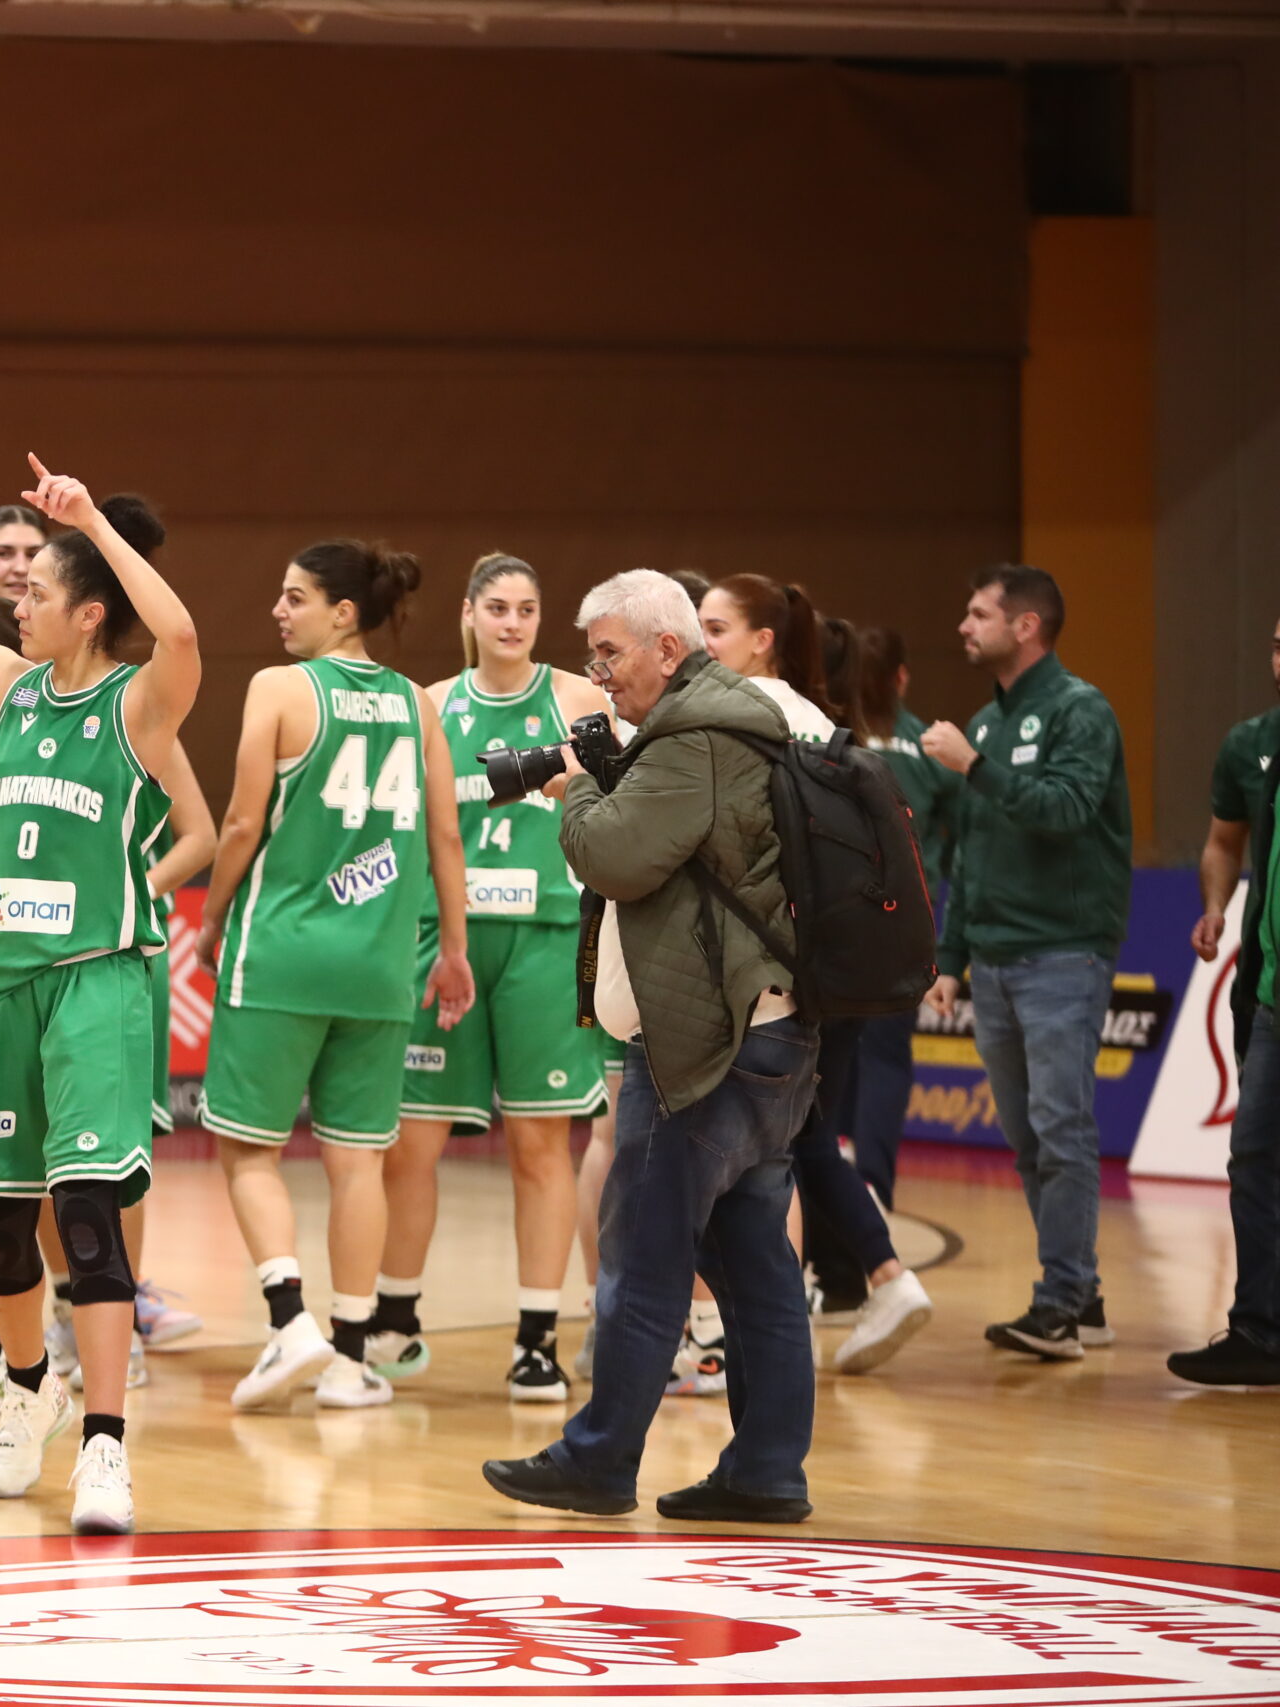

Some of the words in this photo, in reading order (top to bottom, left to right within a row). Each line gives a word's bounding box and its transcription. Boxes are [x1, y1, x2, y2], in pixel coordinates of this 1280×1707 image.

[320, 734, 421, 831] 44
[17, 821, 40, 860] 0
[478, 817, 512, 853] 14
[328, 855, 395, 901] Viva
[644, 1574, 1143, 1660] BASKETBALL
